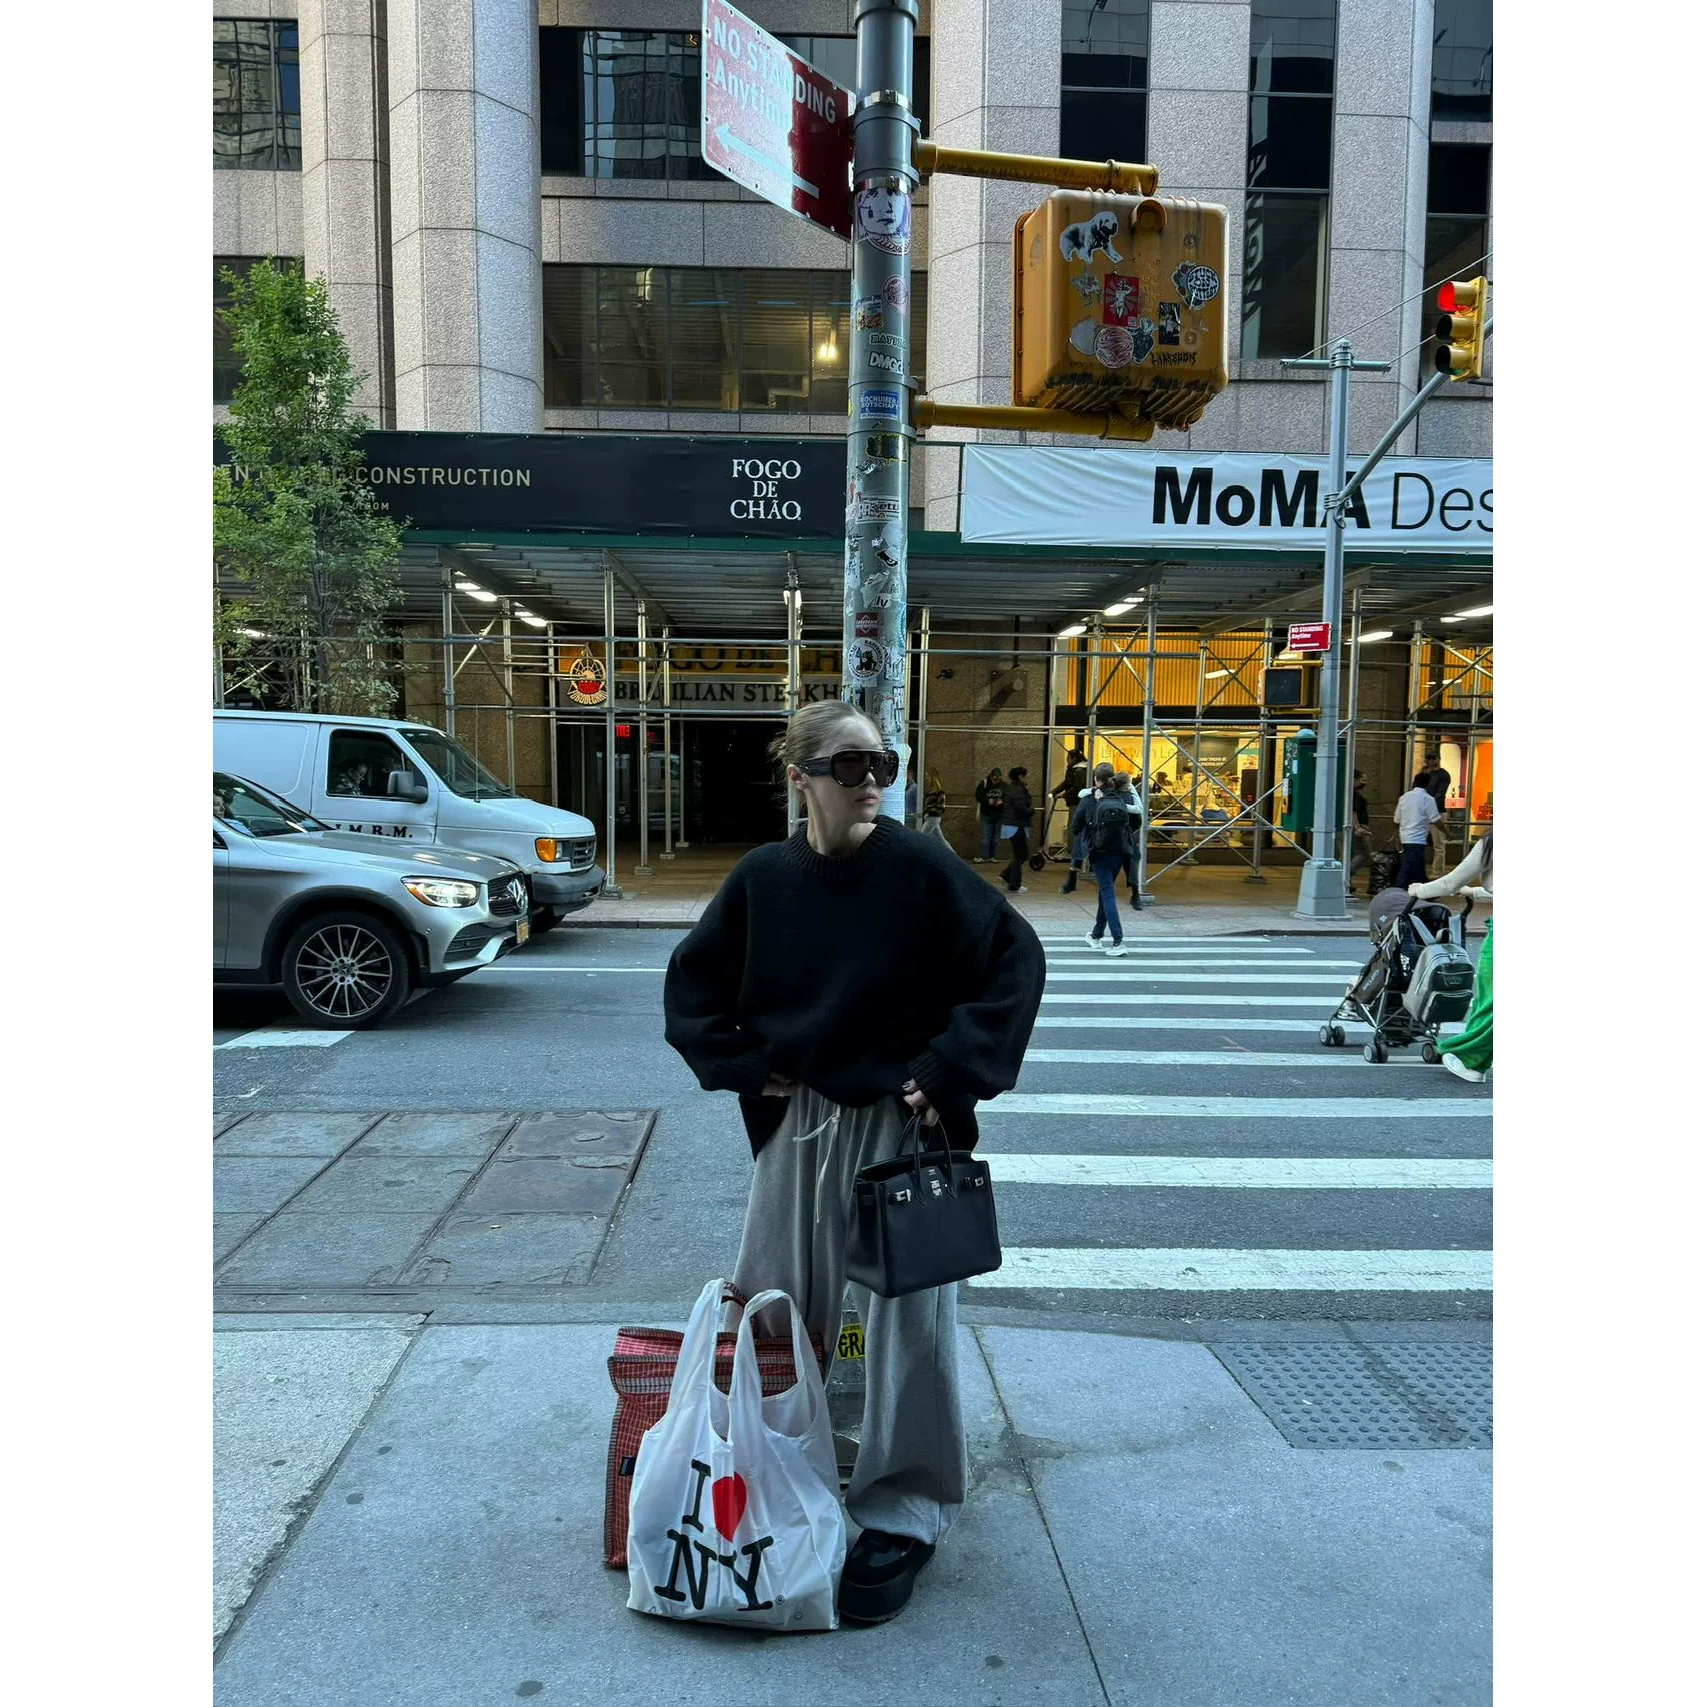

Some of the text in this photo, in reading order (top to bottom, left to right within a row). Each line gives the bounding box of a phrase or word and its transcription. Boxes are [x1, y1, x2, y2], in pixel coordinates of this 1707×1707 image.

[713, 16, 836, 124] NO STANDING
[355, 466, 531, 487] CONSTRUCTION
[731, 458, 801, 479] FOGO
[752, 480, 778, 498] DE
[730, 499, 801, 520] CHÃO
[1152, 466, 1371, 529] MoMA
[682, 1459, 711, 1533] I
[654, 1529, 774, 1612] NY
